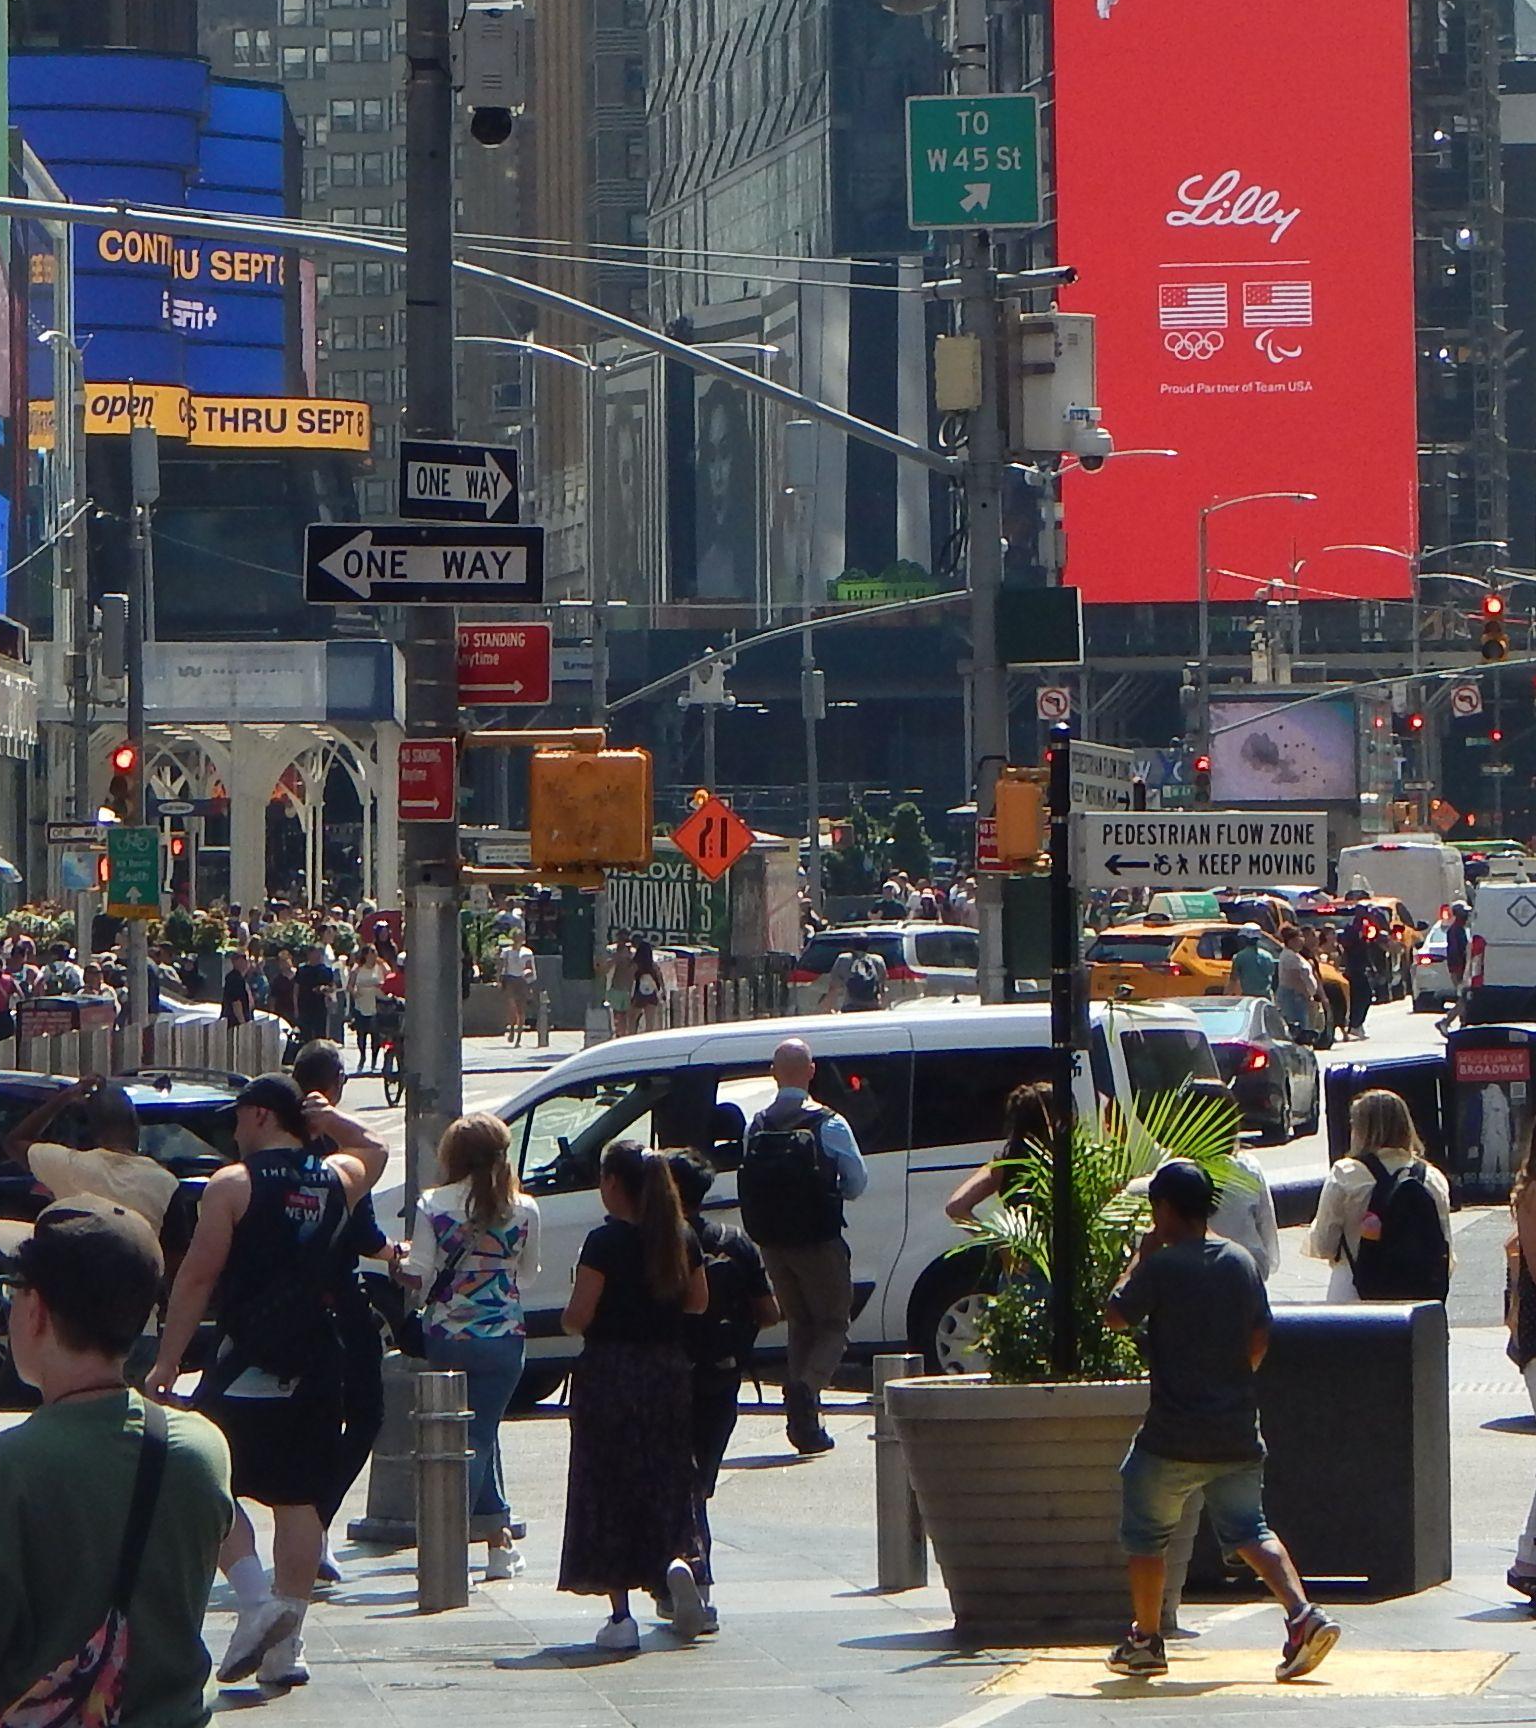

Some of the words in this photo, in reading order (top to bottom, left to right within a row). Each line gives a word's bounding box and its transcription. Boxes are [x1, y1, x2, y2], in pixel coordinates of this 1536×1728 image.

[955, 110, 990, 137] TO
[926, 147, 953, 172] W
[953, 147, 990, 172] 45
[996, 146, 1022, 171] St
[1166, 169, 1302, 245] Lilly
[210, 249, 276, 285] SEPT
[1160, 383, 1195, 395] Proud
[1197, 381, 1240, 394] Partner
[1242, 381, 1253, 393] of
[1255, 380, 1285, 393] Team
[1288, 379, 1313, 393] USA
[91, 392, 154, 427] open
[203, 405, 287, 434] THRU
[297, 407, 355, 436] SEPT
[357, 411, 365, 437] 8
[415, 465, 451, 498] ONE
[465, 468, 501, 501] WAY
[342, 549, 408, 580] ONE
[442, 550, 512, 580] WAY
[473, 632, 526, 648] STANDING
[459, 652, 500, 670] nytime
[1102, 823, 1211, 846] PEDESTRIAN
[1216, 823, 1264, 846] FLOW
[1269, 823, 1316, 846] ZONE
[1198, 853, 1242, 876] KEEP
[1248, 853, 1316, 876] MOVING
[1458, 1063, 1525, 1076] BROADWAY
[261, 1167, 287, 1178] THE
[284, 1205, 319, 1222] NEW
